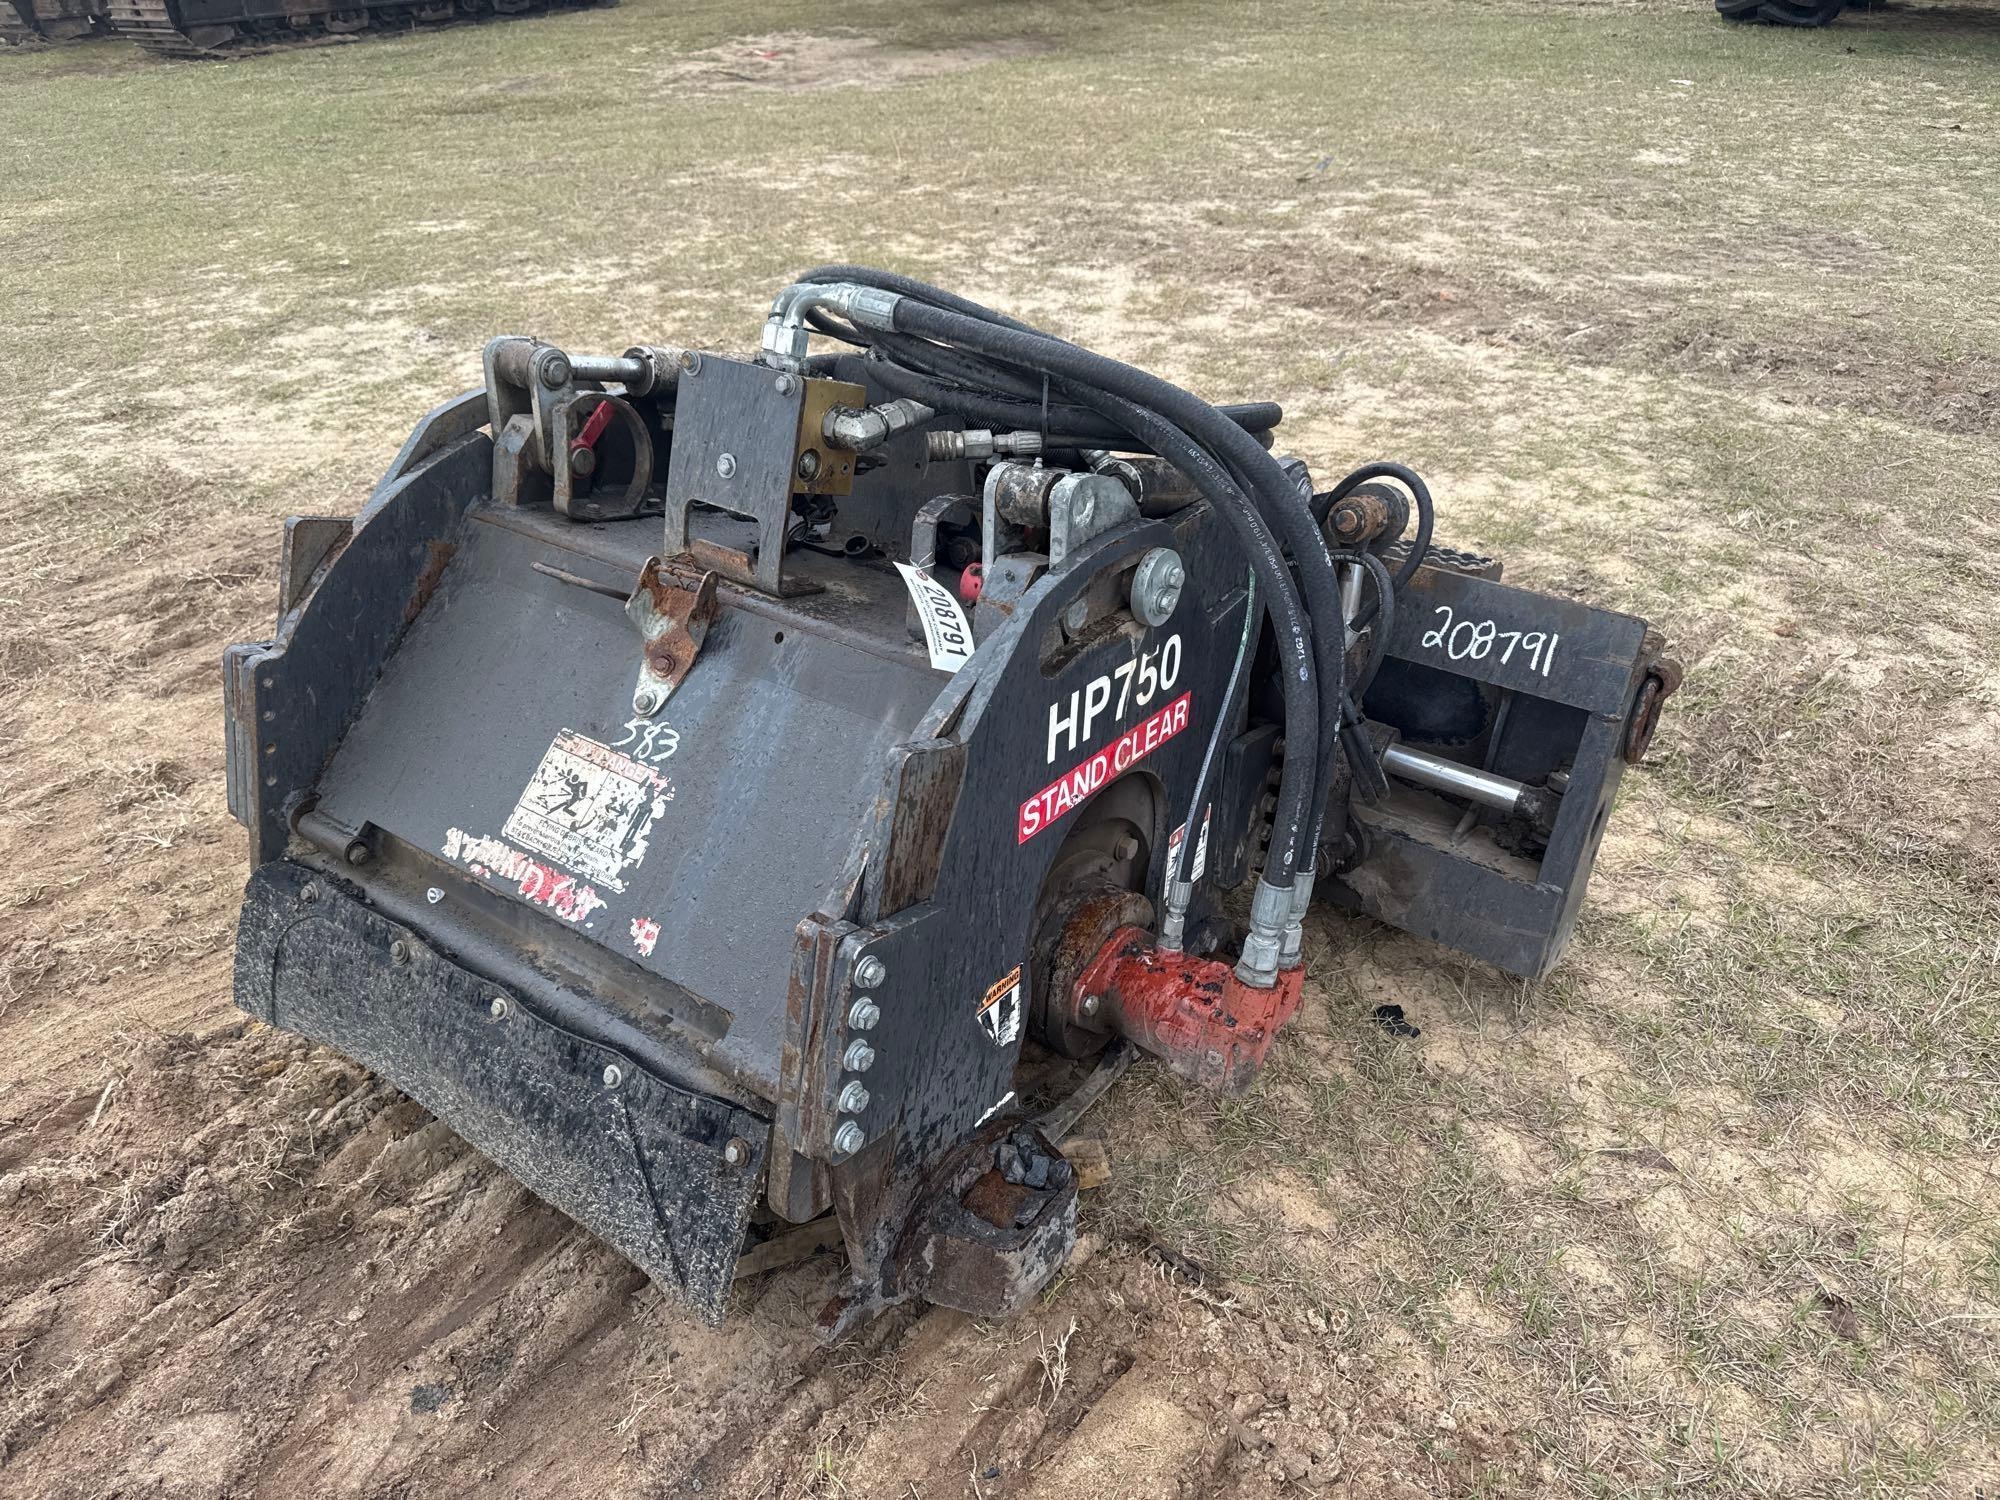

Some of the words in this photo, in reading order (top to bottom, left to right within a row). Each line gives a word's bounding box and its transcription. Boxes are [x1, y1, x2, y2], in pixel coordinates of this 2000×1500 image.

[924, 586, 967, 656] 208791
[925, 599, 936, 622] AUCTION
[934, 623, 944, 652] COMPANY
[1422, 606, 1559, 677] 208791
[1295, 636, 1306, 660] 12G2
[1047, 634, 1182, 764] HP750
[612, 720, 680, 762] 583
[1022, 756, 1108, 836] STAND
[1114, 699, 1188, 772] CLEAR
[538, 819, 561, 834] FLYING
[985, 971, 1019, 1003] WARNING
